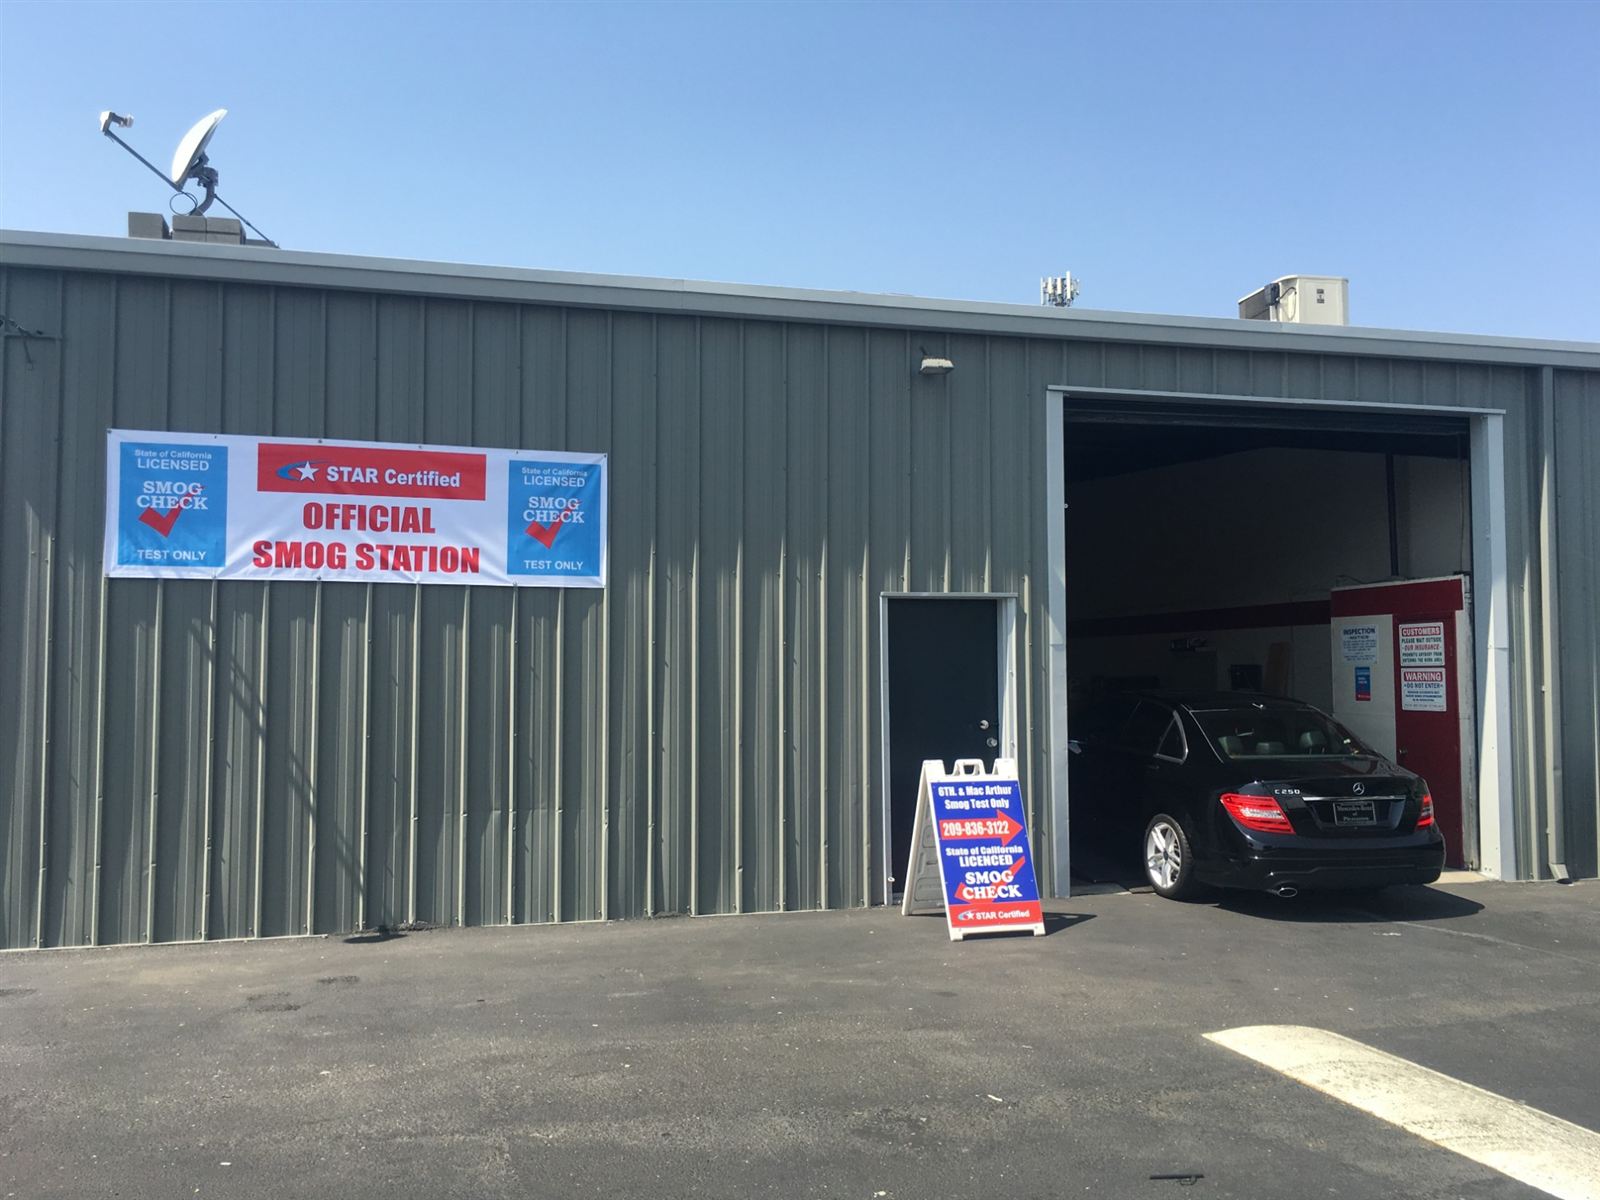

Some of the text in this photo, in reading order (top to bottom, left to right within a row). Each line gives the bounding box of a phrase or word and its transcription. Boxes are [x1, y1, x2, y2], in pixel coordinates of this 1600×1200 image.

[135, 449, 212, 460] State of California
[137, 458, 209, 471] LICENSED
[326, 466, 461, 487] STAR Certified
[522, 467, 588, 477] State of California
[143, 481, 203, 495] SMOG
[524, 475, 585, 488] LICENSED
[136, 495, 209, 510] CHECK
[528, 496, 579, 510] SMOG
[303, 502, 436, 534] OFFICIAL
[523, 509, 585, 523] CHECK
[137, 550, 206, 561] TEST ONLY
[252, 540, 480, 573] SMOG STATION
[524, 560, 584, 571] TEST ONLY
[1402, 627, 1440, 636] CUSTOMERS
[1405, 672, 1441, 681] WARNING
[958, 786, 965, 796] &
[966, 786, 984, 796] Mac
[985, 785, 1012, 796] Arthur
[944, 798, 1010, 811] Smog Test Only
[942, 820, 1010, 837] 209-836-3122
[945, 845, 1024, 856] State of California
[959, 854, 1014, 868] LICENCED
[965, 870, 1014, 885] SMOG
[962, 884, 1023, 900] CHECK
[975, 909, 1031, 920] STAR Certified
